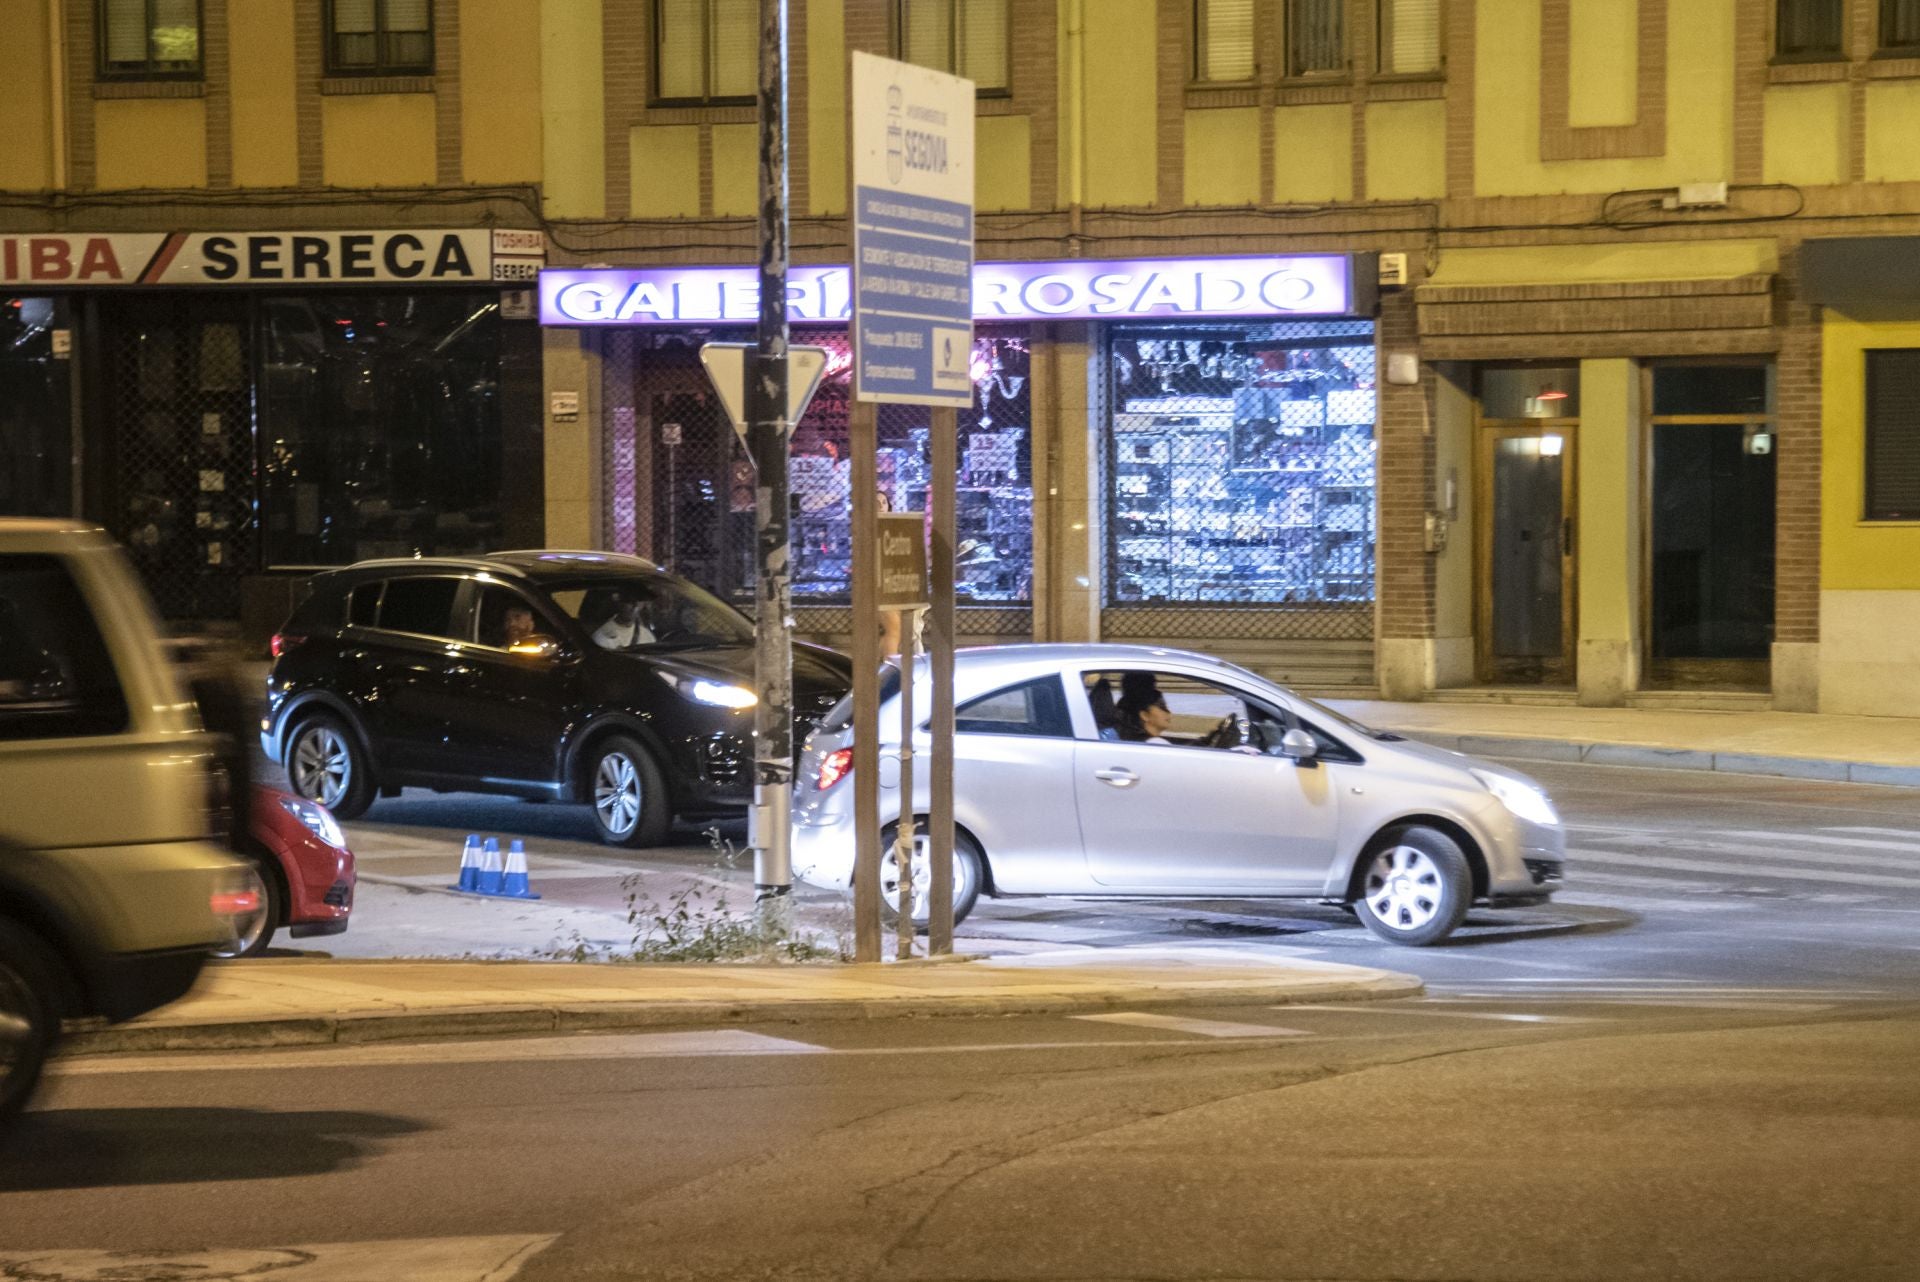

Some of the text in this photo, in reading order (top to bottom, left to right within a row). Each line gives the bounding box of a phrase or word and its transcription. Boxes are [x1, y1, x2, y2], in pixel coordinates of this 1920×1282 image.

[904, 129, 948, 174] SEGOVIA
[202, 233, 474, 280] SERECA
[495, 232, 543, 249] TOSHIBA
[555, 268, 852, 321] GALERÍ
[883, 529, 912, 556] Centro
